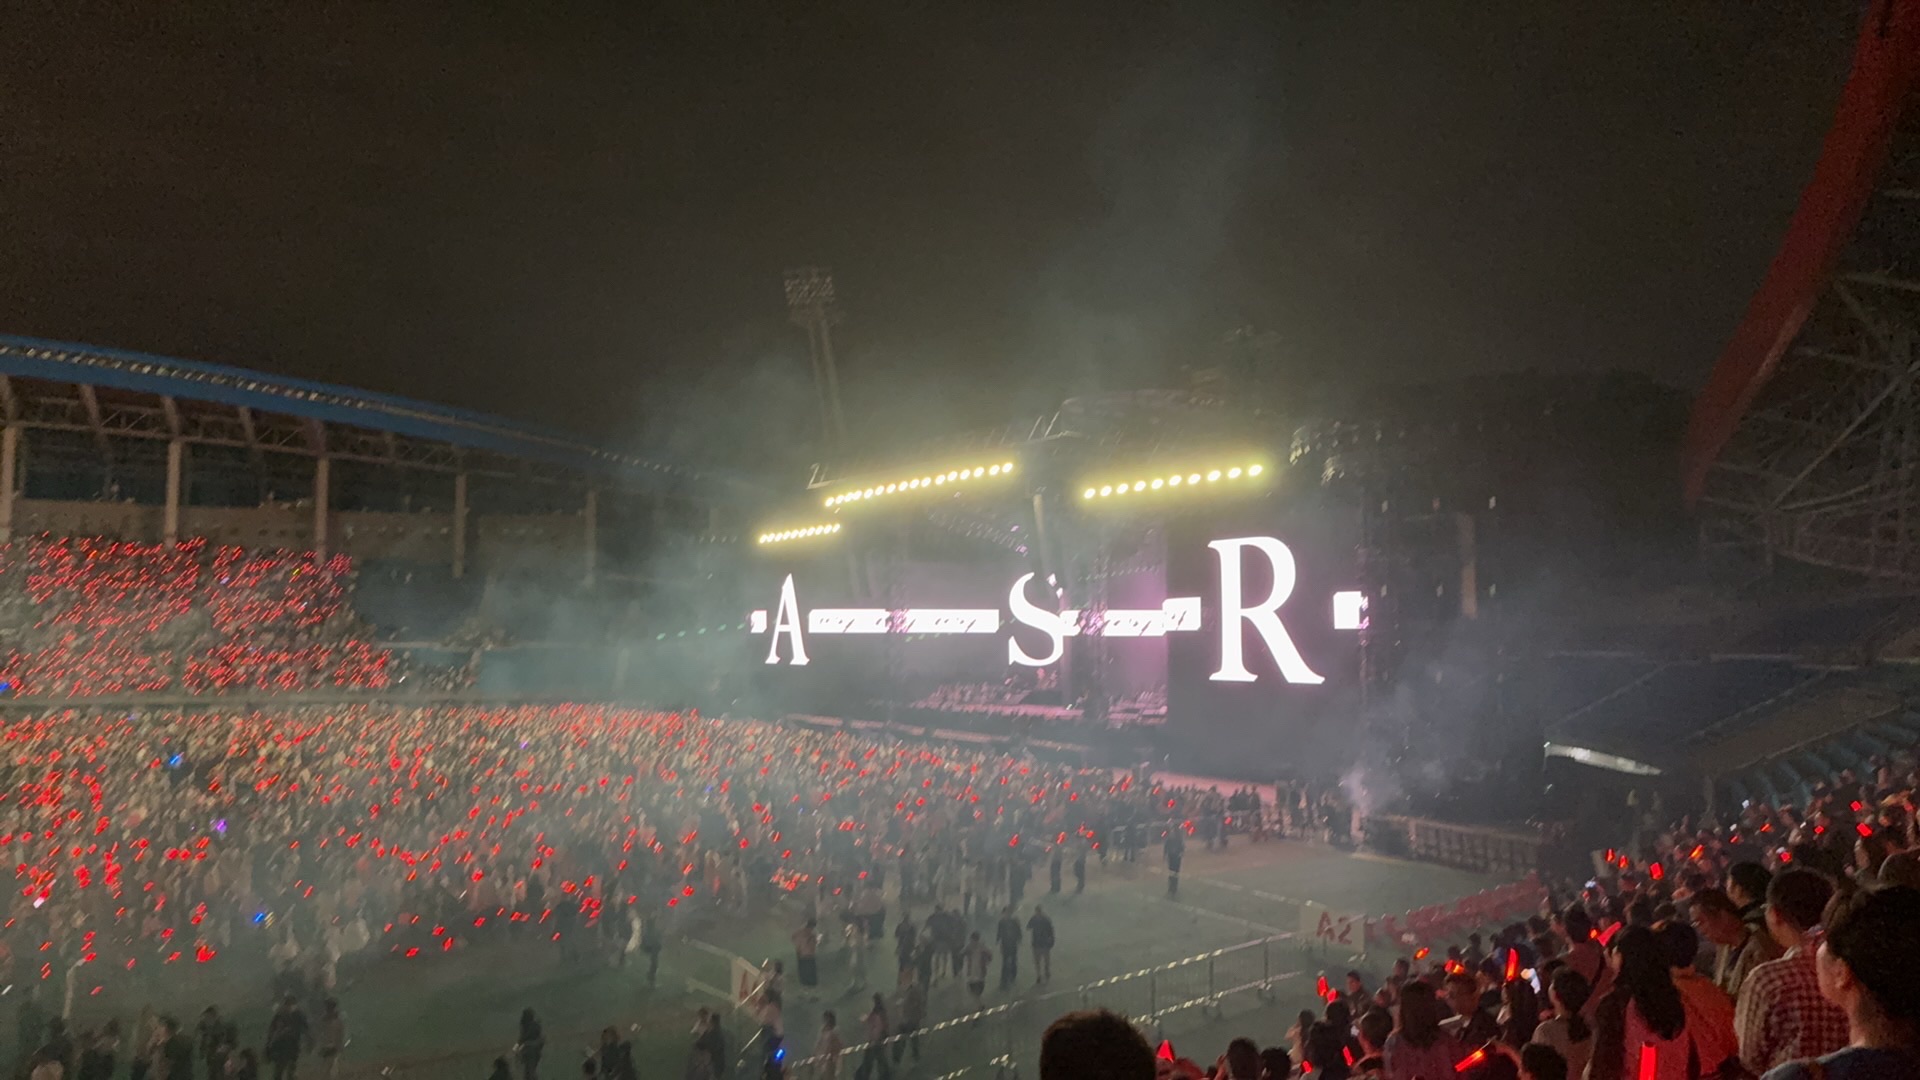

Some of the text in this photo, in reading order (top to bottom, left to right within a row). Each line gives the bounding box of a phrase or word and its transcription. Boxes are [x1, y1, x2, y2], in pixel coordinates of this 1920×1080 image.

[764, 536, 1325, 685] A S R
[1316, 911, 1352, 945] A2
